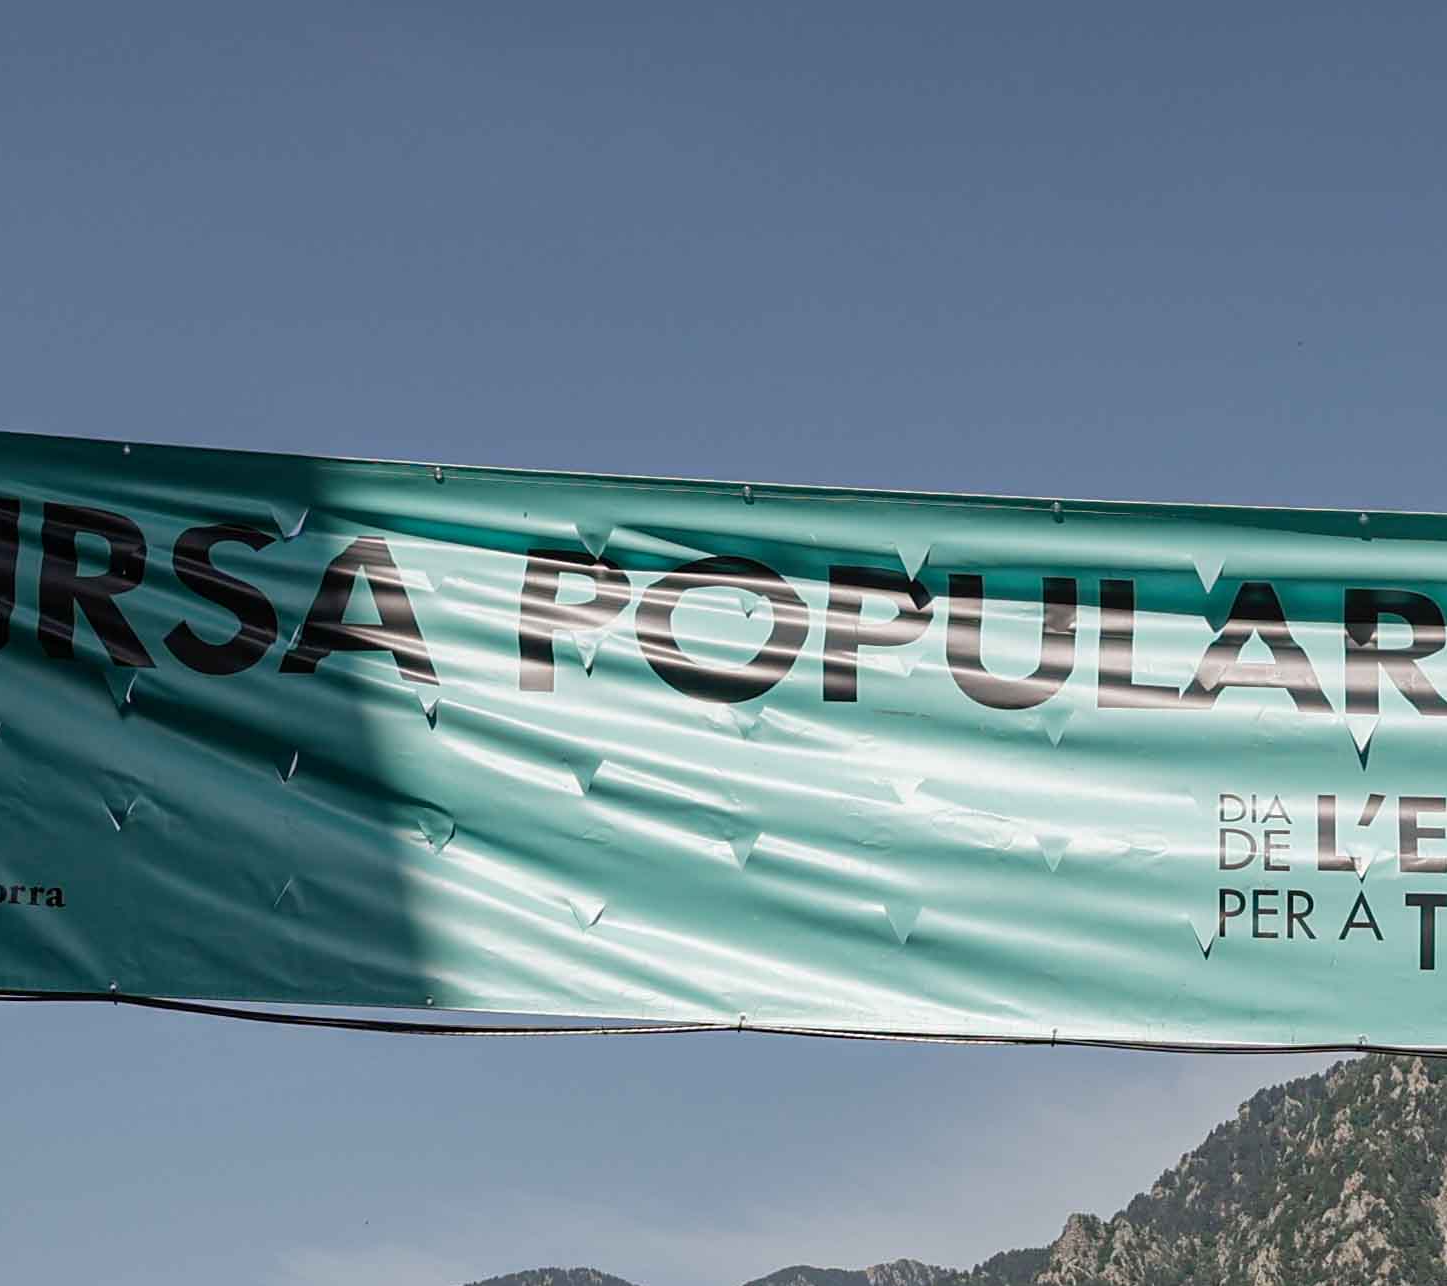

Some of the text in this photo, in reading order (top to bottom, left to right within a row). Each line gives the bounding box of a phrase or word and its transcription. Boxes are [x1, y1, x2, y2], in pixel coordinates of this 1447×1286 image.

[1217, 794, 1293, 873] DIA DE
[1217, 888, 1317, 941] PER
[1340, 891, 1385, 942] A
